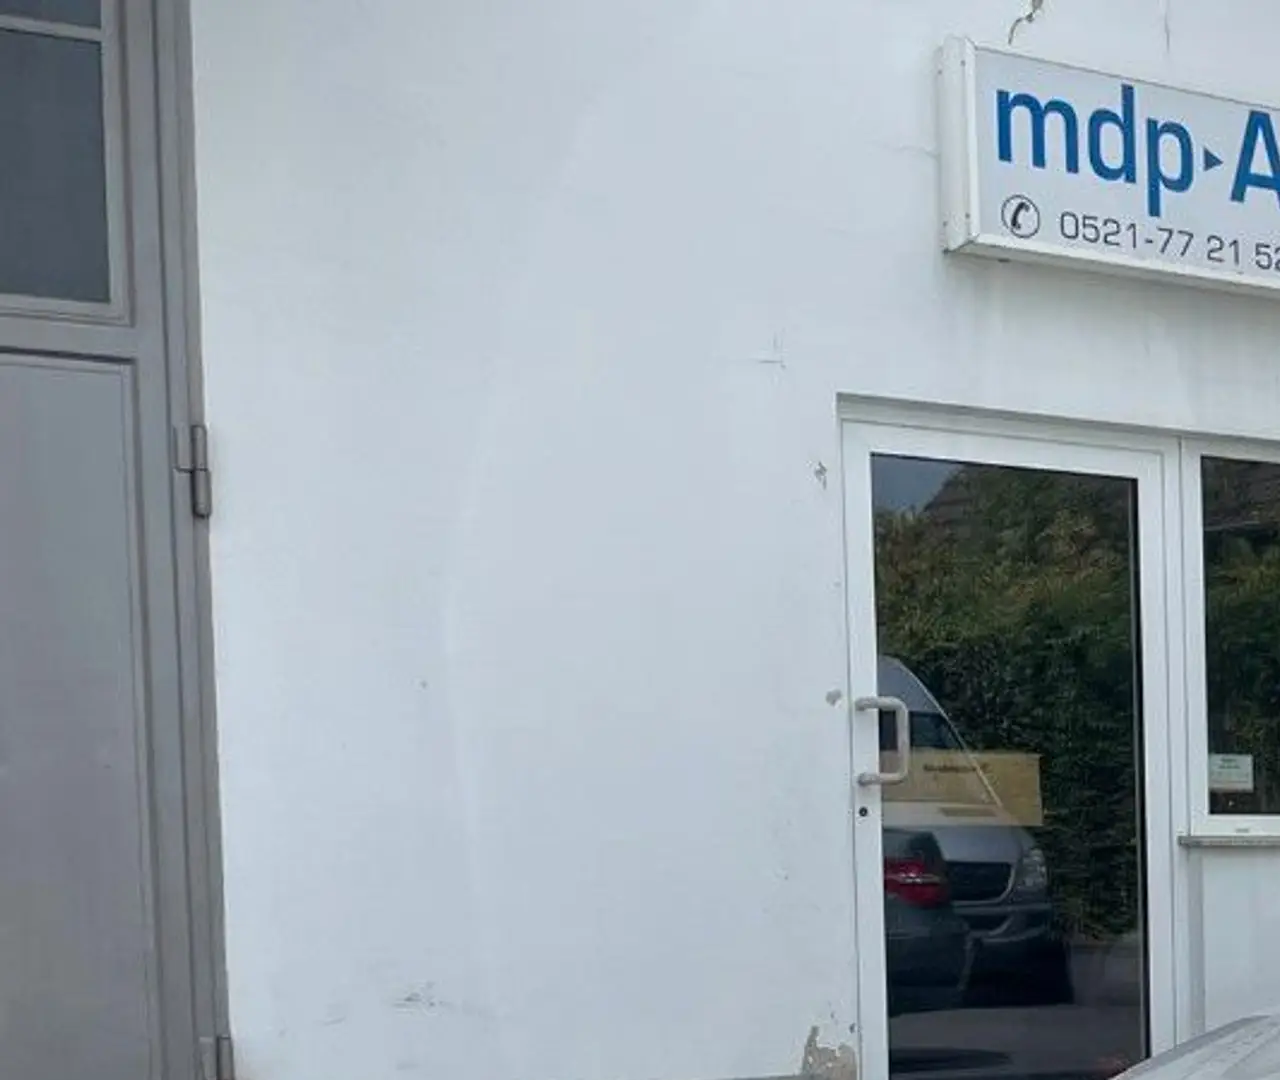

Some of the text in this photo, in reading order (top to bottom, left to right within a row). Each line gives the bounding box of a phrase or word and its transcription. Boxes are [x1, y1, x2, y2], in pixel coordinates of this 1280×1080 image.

[996, 85, 1193, 217] mdp
[1059, 211, 1194, 257] 0521-77
[1207, 235, 1241, 266] 21
